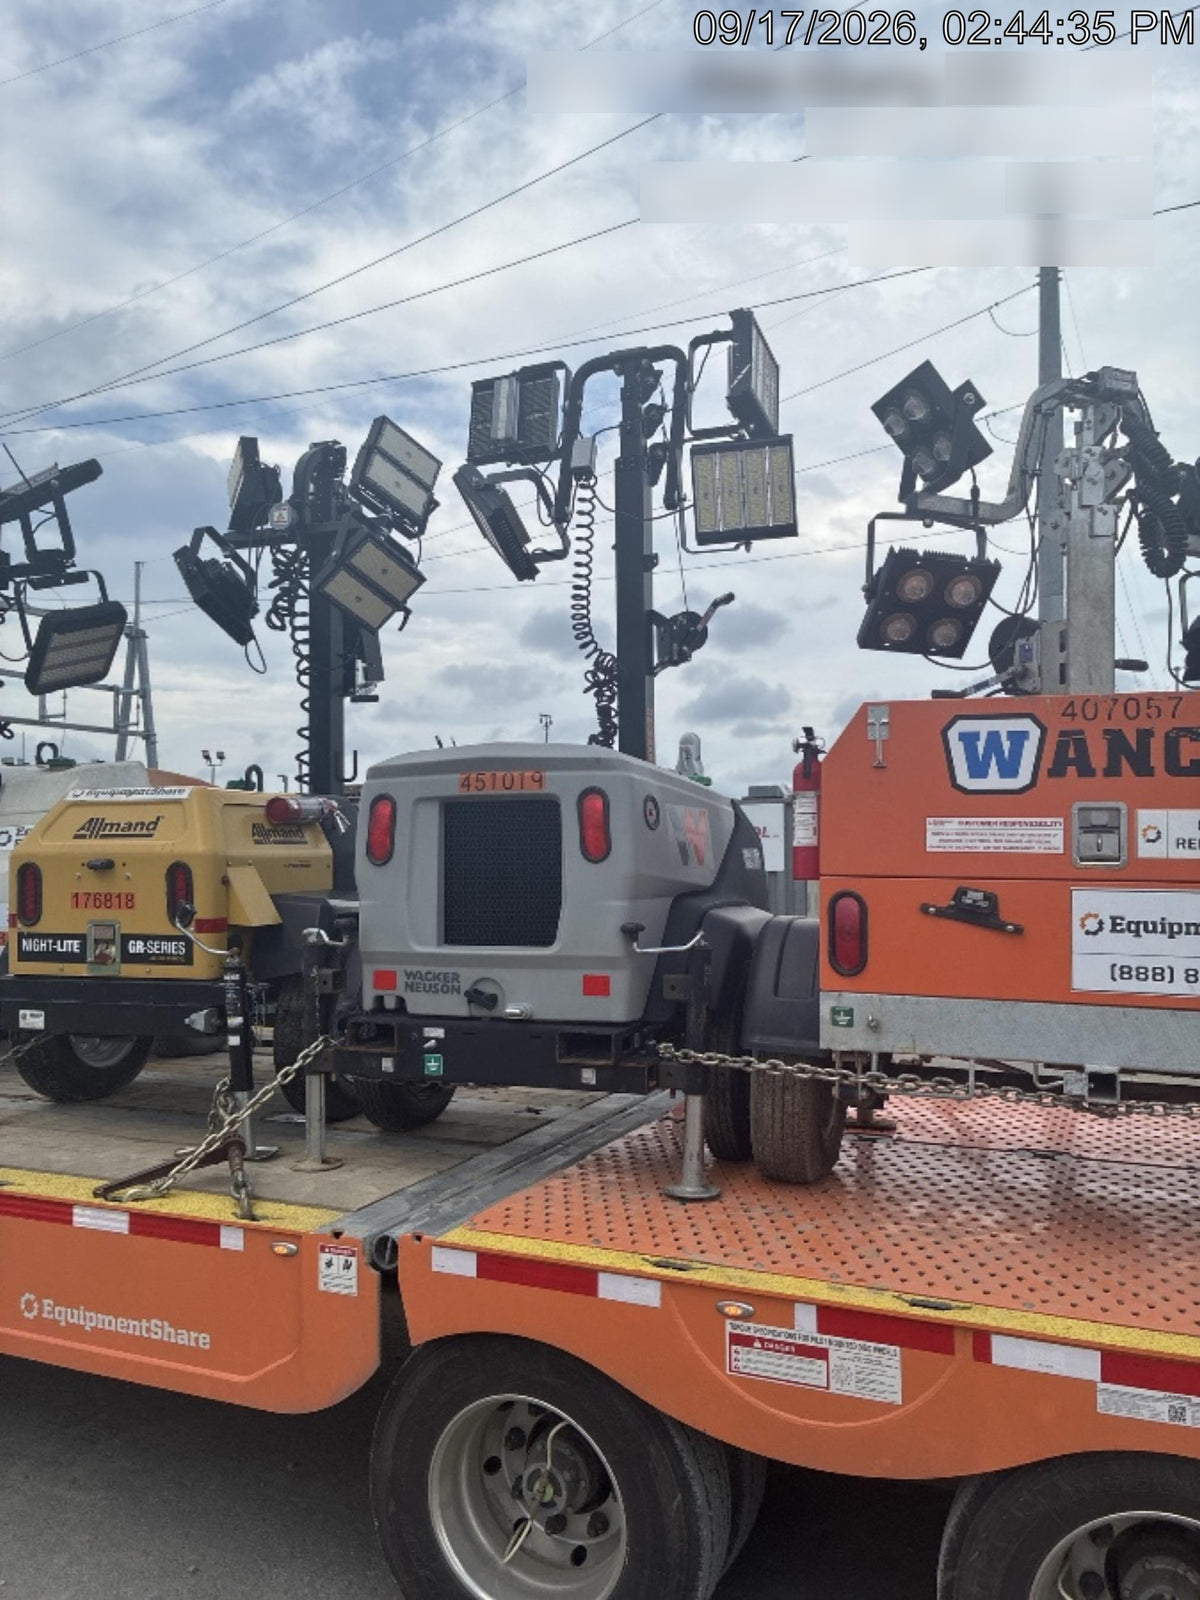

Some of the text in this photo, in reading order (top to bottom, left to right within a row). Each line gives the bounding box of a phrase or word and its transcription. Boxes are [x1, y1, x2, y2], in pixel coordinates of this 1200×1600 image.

[1060, 696, 1184, 721] 407057
[460, 771, 544, 791] 451019
[73, 815, 162, 839] Allmand
[1176, 837, 1200, 850] RE
[71, 892, 135, 910] 176818
[21, 937, 82, 954] NIGHT-LITE
[127, 939, 186, 955] GR-SERIES
[404, 969, 461, 984] WACKER
[1110, 963, 1175, 984] (888)
[404, 980, 462, 995] NEUSON
[42, 1298, 211, 1350] EquipmentShare
